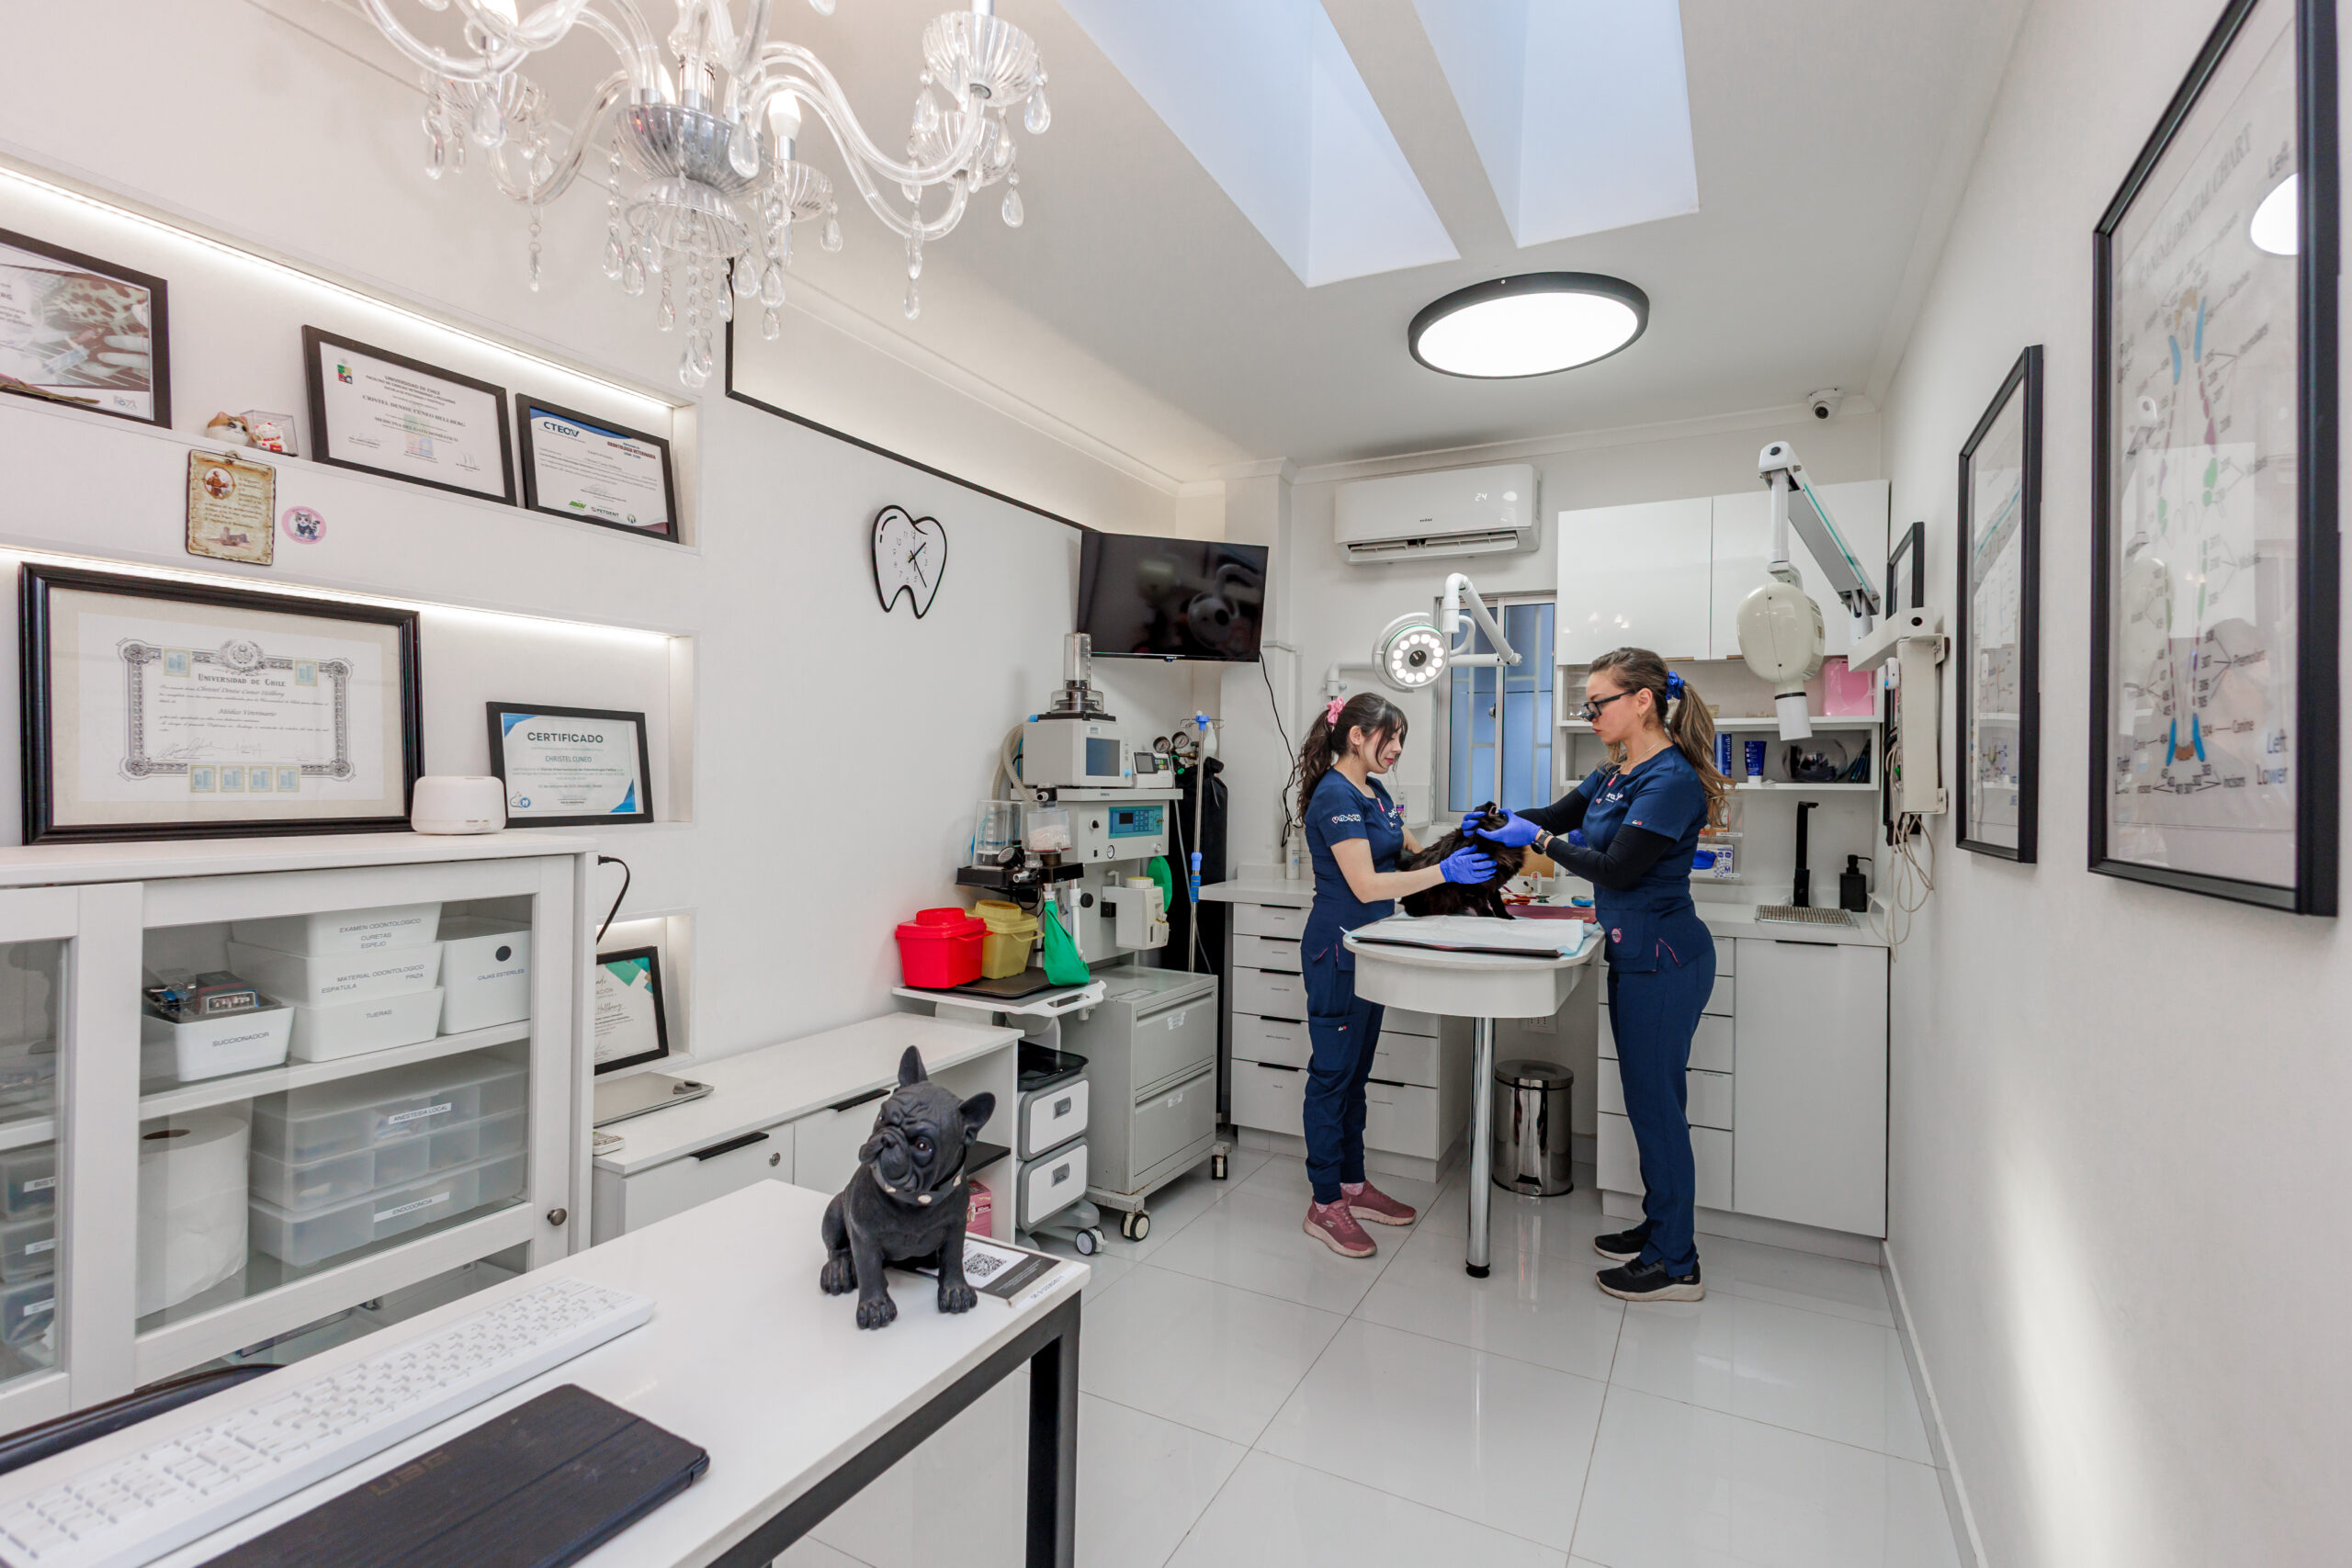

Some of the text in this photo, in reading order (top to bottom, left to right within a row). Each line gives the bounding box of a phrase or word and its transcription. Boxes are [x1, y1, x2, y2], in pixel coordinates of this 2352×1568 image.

[2212, 120, 2253, 194] CHART
[1475, 492, 1487, 501] 24
[527, 732, 604, 744] CERTIFICADO
[2267, 728, 2288, 754] Left
[2256, 763, 2288, 786] Lower
[339, 918, 421, 933] EXAMEN ODONTOLOGICO
[361, 932, 392, 941] CURETAS
[337, 964, 425, 982] MATERIAL ODONTOLOGICO
[322, 983, 357, 993] ESPATULA
[213, 1032, 269, 1047] SUCCIONADOR
[394, 1110, 428, 1121] ANESTESIA
[392, 1199, 432, 1214] ENDODONCIA
